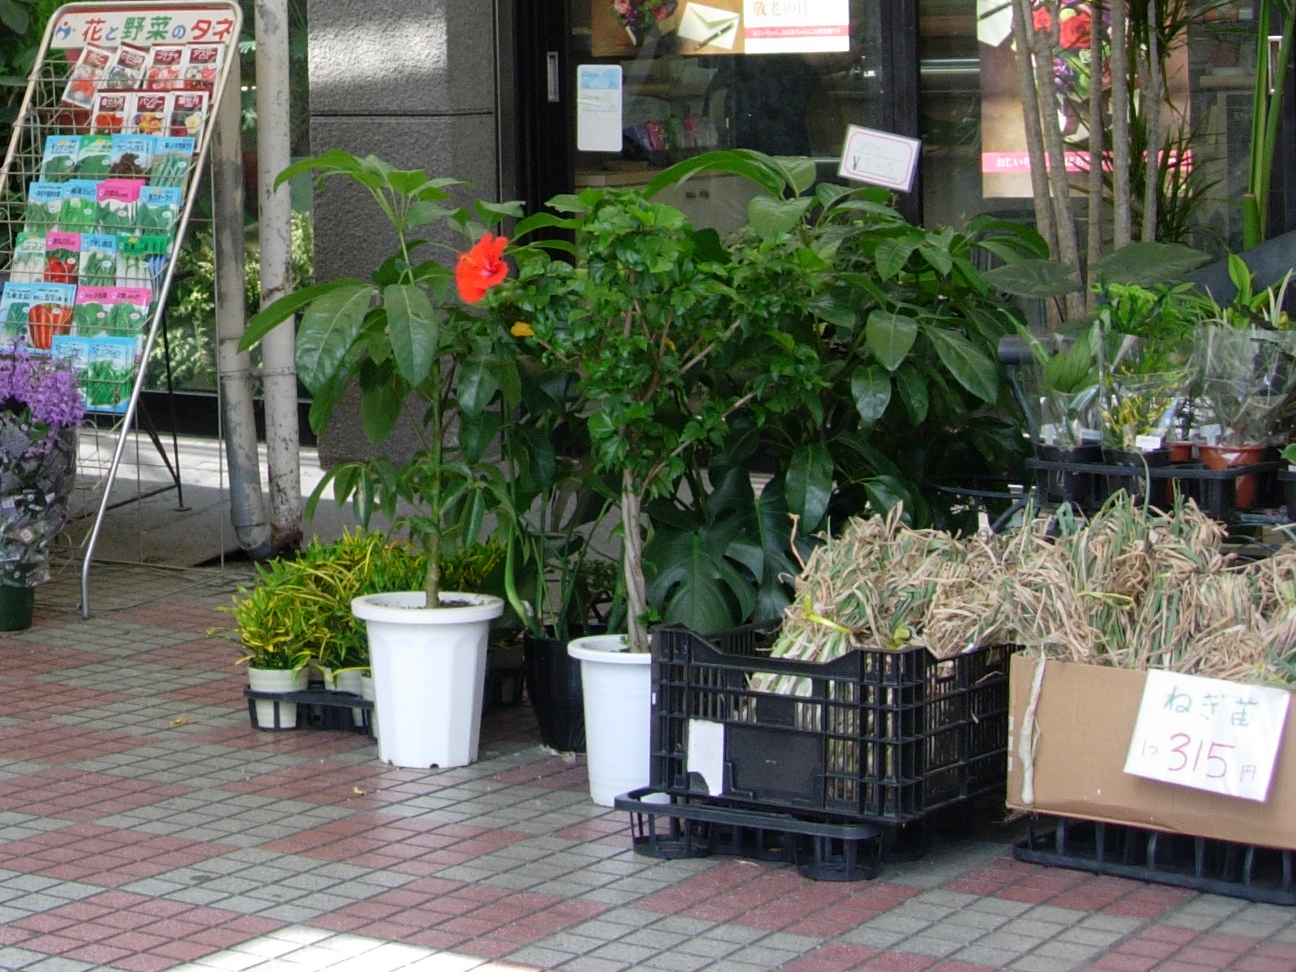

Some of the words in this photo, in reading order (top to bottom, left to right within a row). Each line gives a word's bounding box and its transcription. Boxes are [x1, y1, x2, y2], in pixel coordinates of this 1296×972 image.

[81, 15, 235, 42] 花と野菜のタネ
[1163, 686, 1258, 727] ねぎ苗
[1167, 732, 1256, 783] 315円
